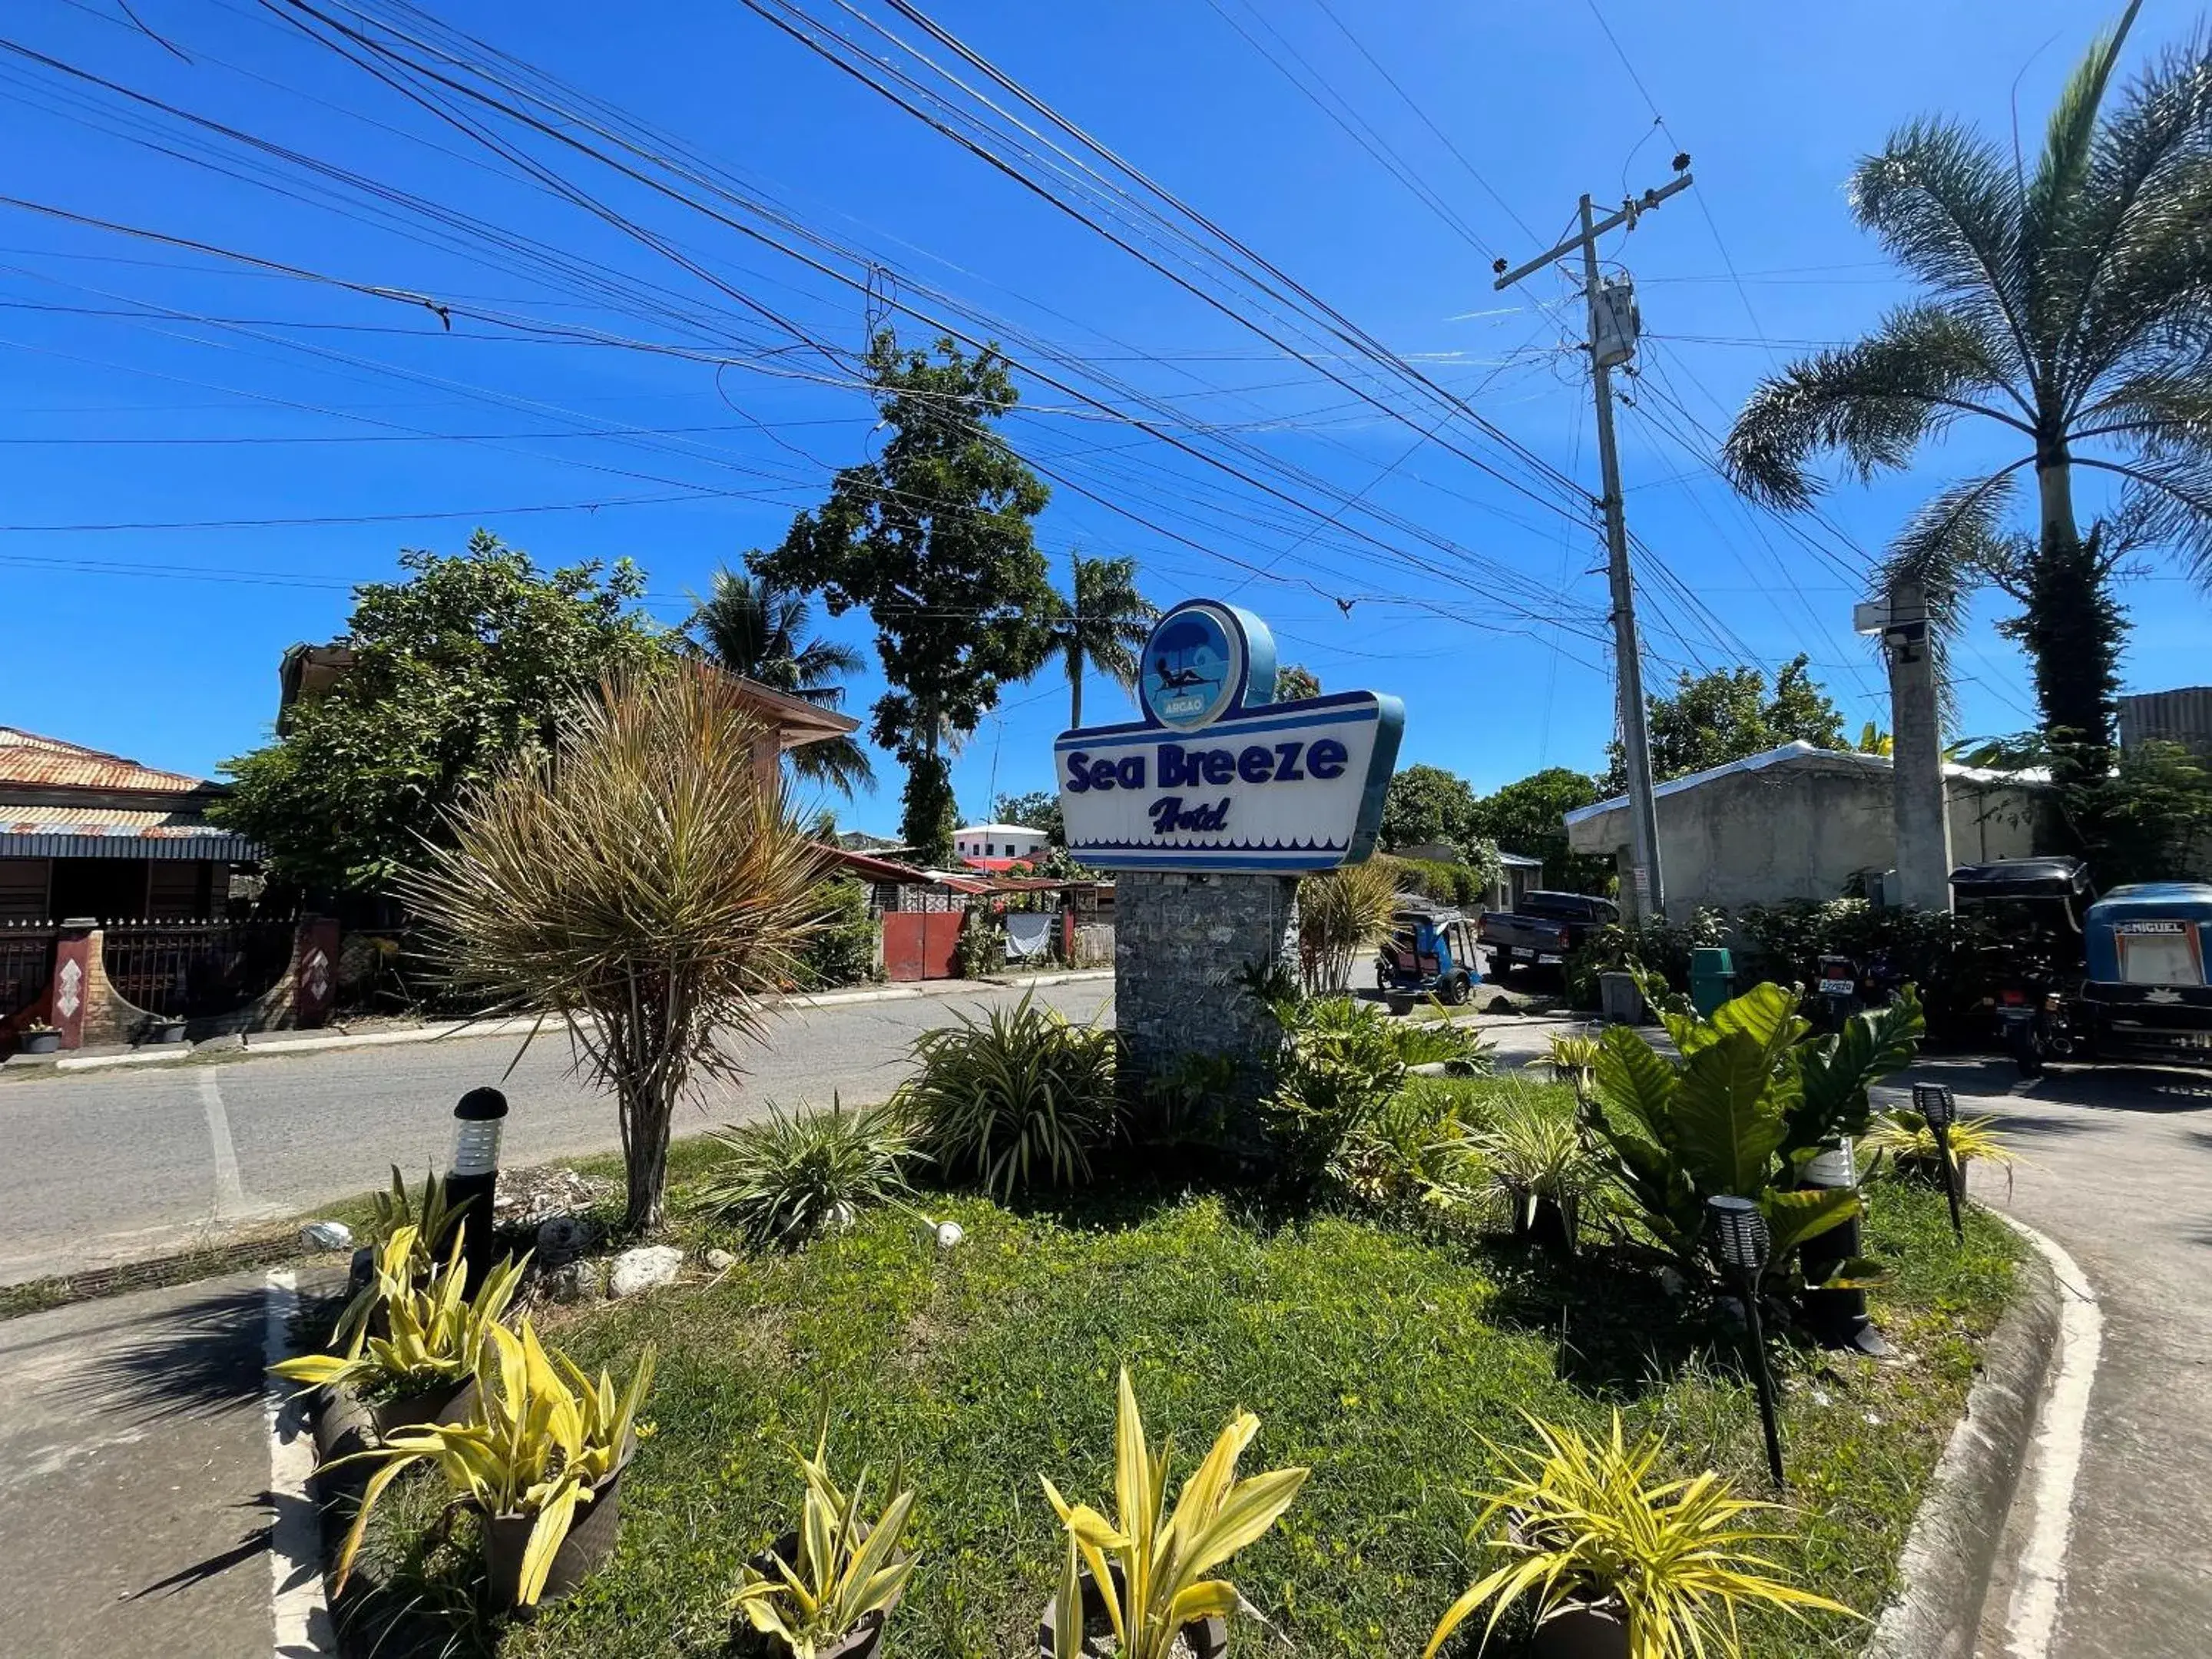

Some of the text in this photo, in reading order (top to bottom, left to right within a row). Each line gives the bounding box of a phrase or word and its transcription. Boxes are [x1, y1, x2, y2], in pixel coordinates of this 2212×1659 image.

[1066, 738, 1349, 793] Sea Breeze
[1148, 796, 1231, 835] Hotel
[2132, 922, 2183, 933] MIGUEL
